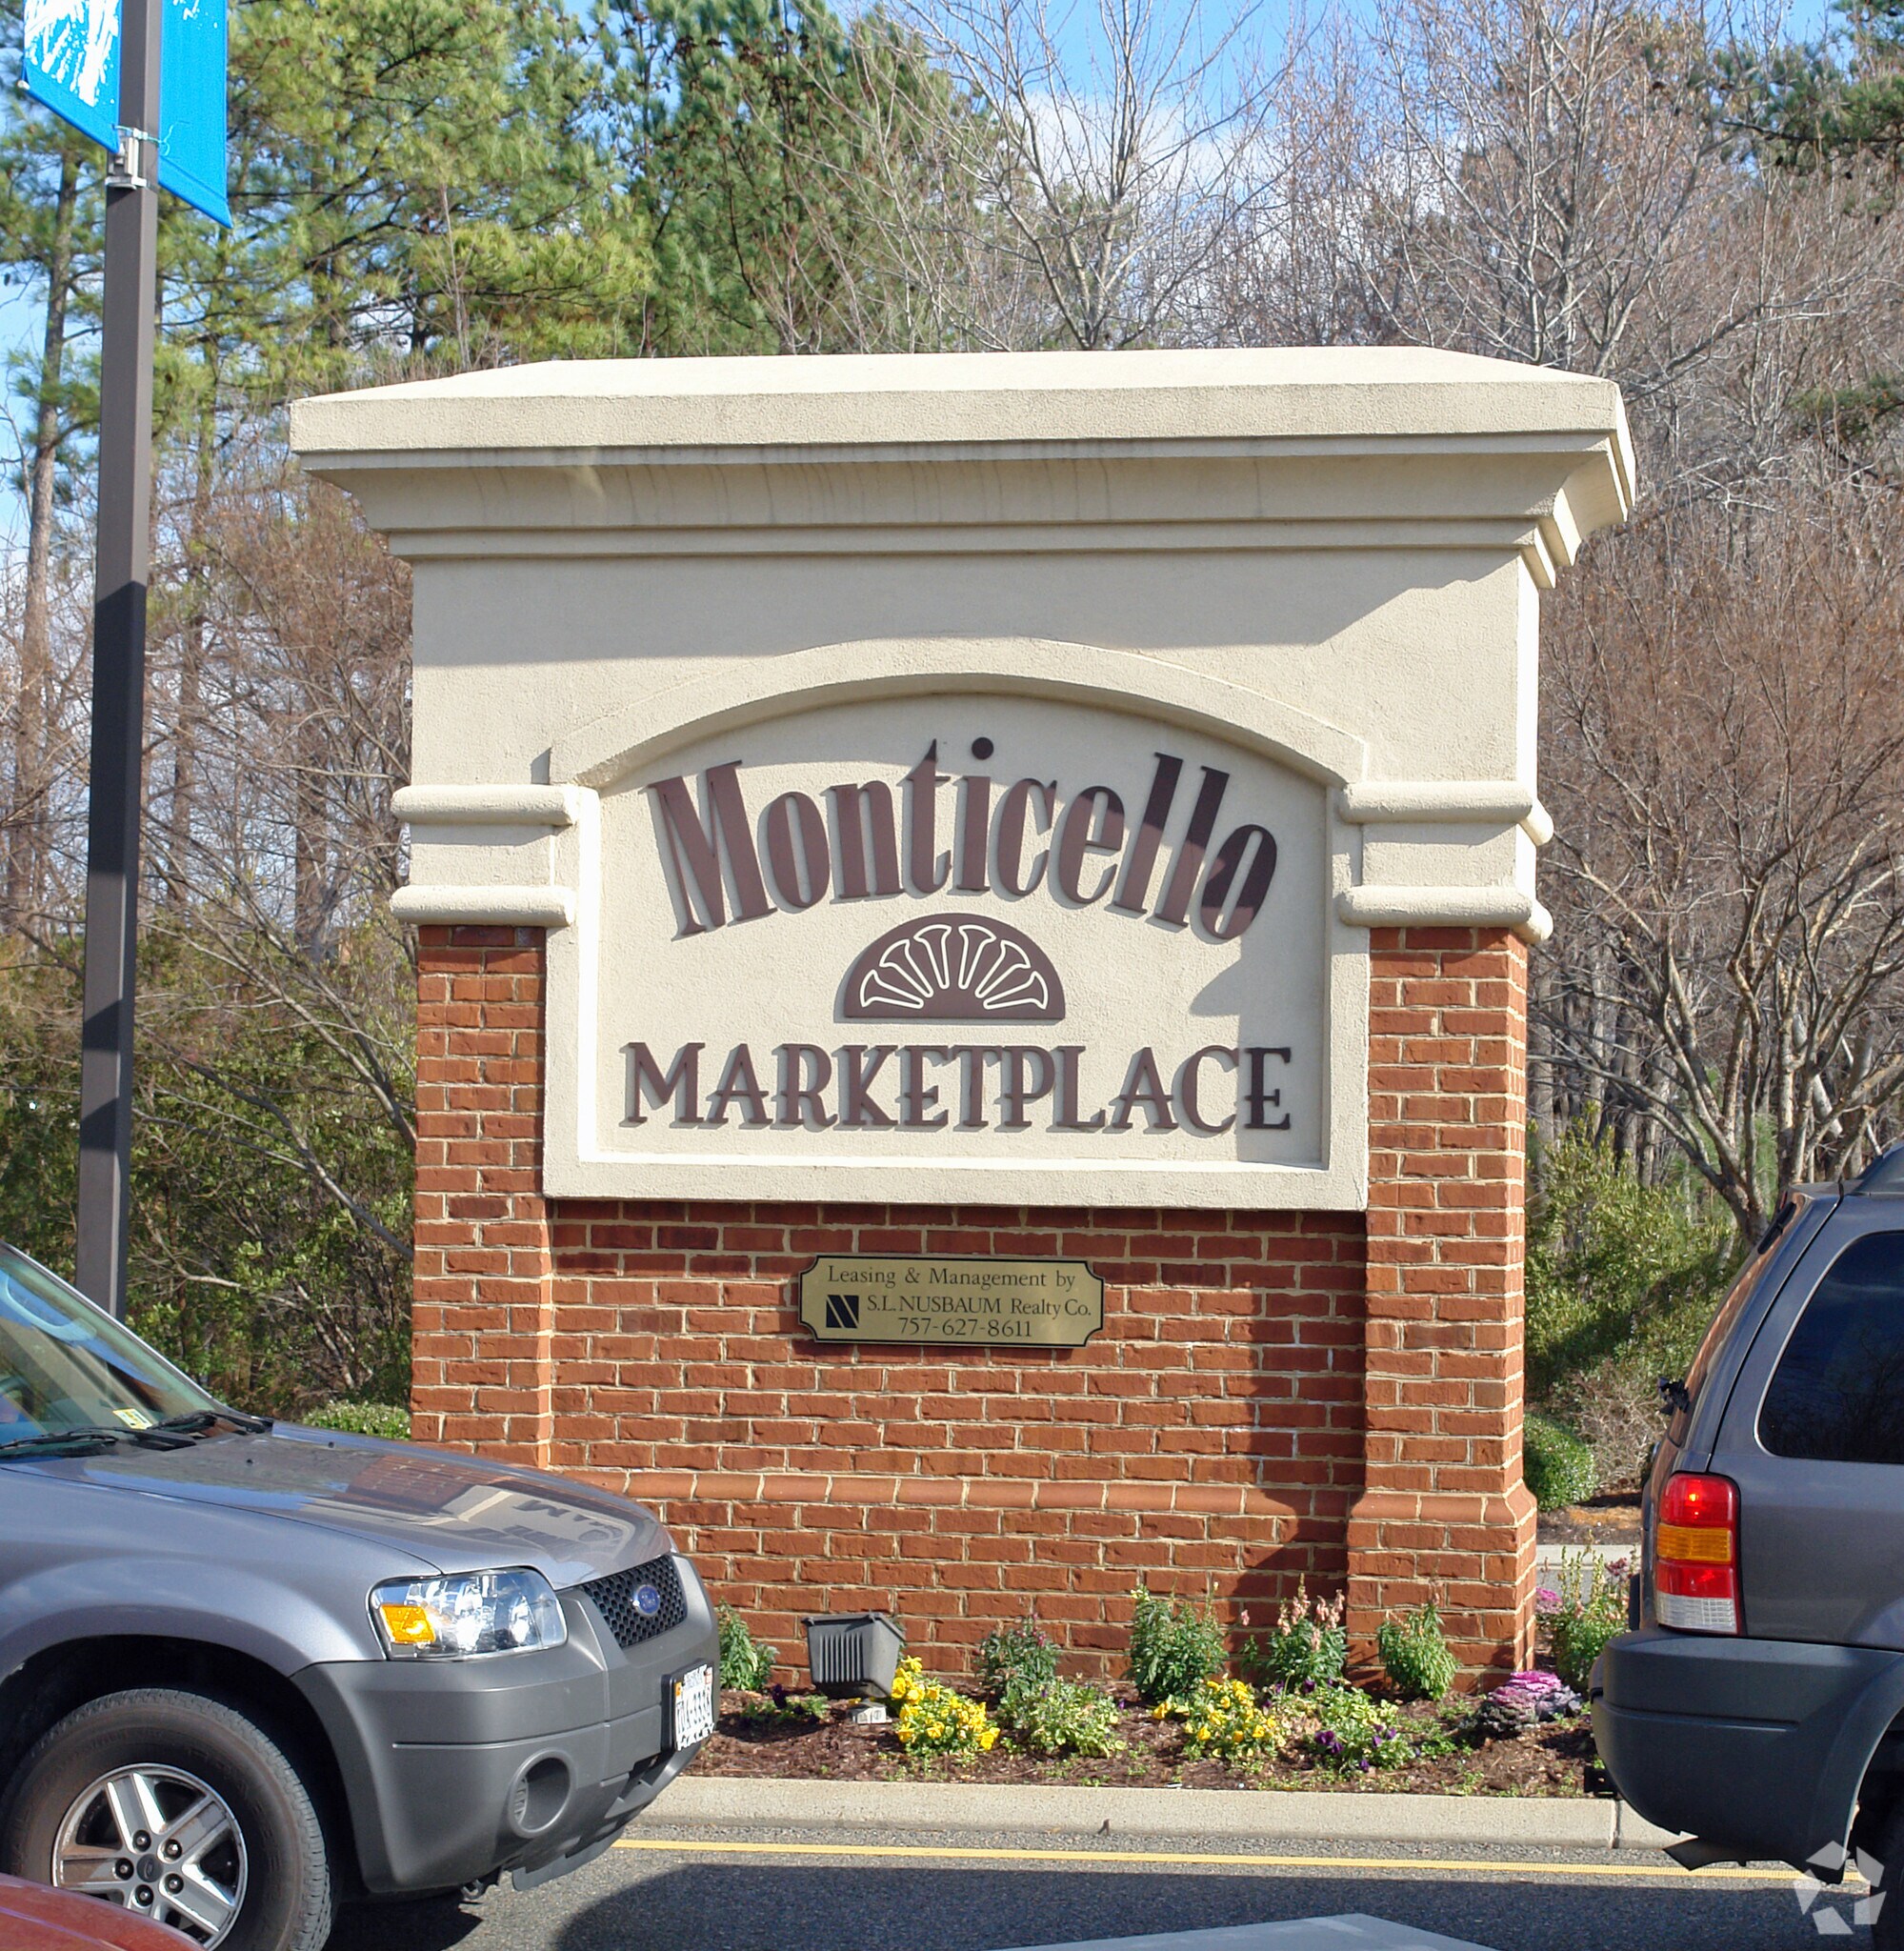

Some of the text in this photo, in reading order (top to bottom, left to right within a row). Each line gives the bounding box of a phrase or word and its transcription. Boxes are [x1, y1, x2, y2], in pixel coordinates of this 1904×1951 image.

[644, 738, 1278, 939] Monticello
[626, 1041, 1293, 1132] MARKETPLACE
[828, 1265, 1076, 1292] Leasing & Management by
[1011, 1297, 1061, 1320] Realty
[1064, 1298, 1092, 1317] Co.
[898, 1317, 1032, 1337] 757-627-8611
